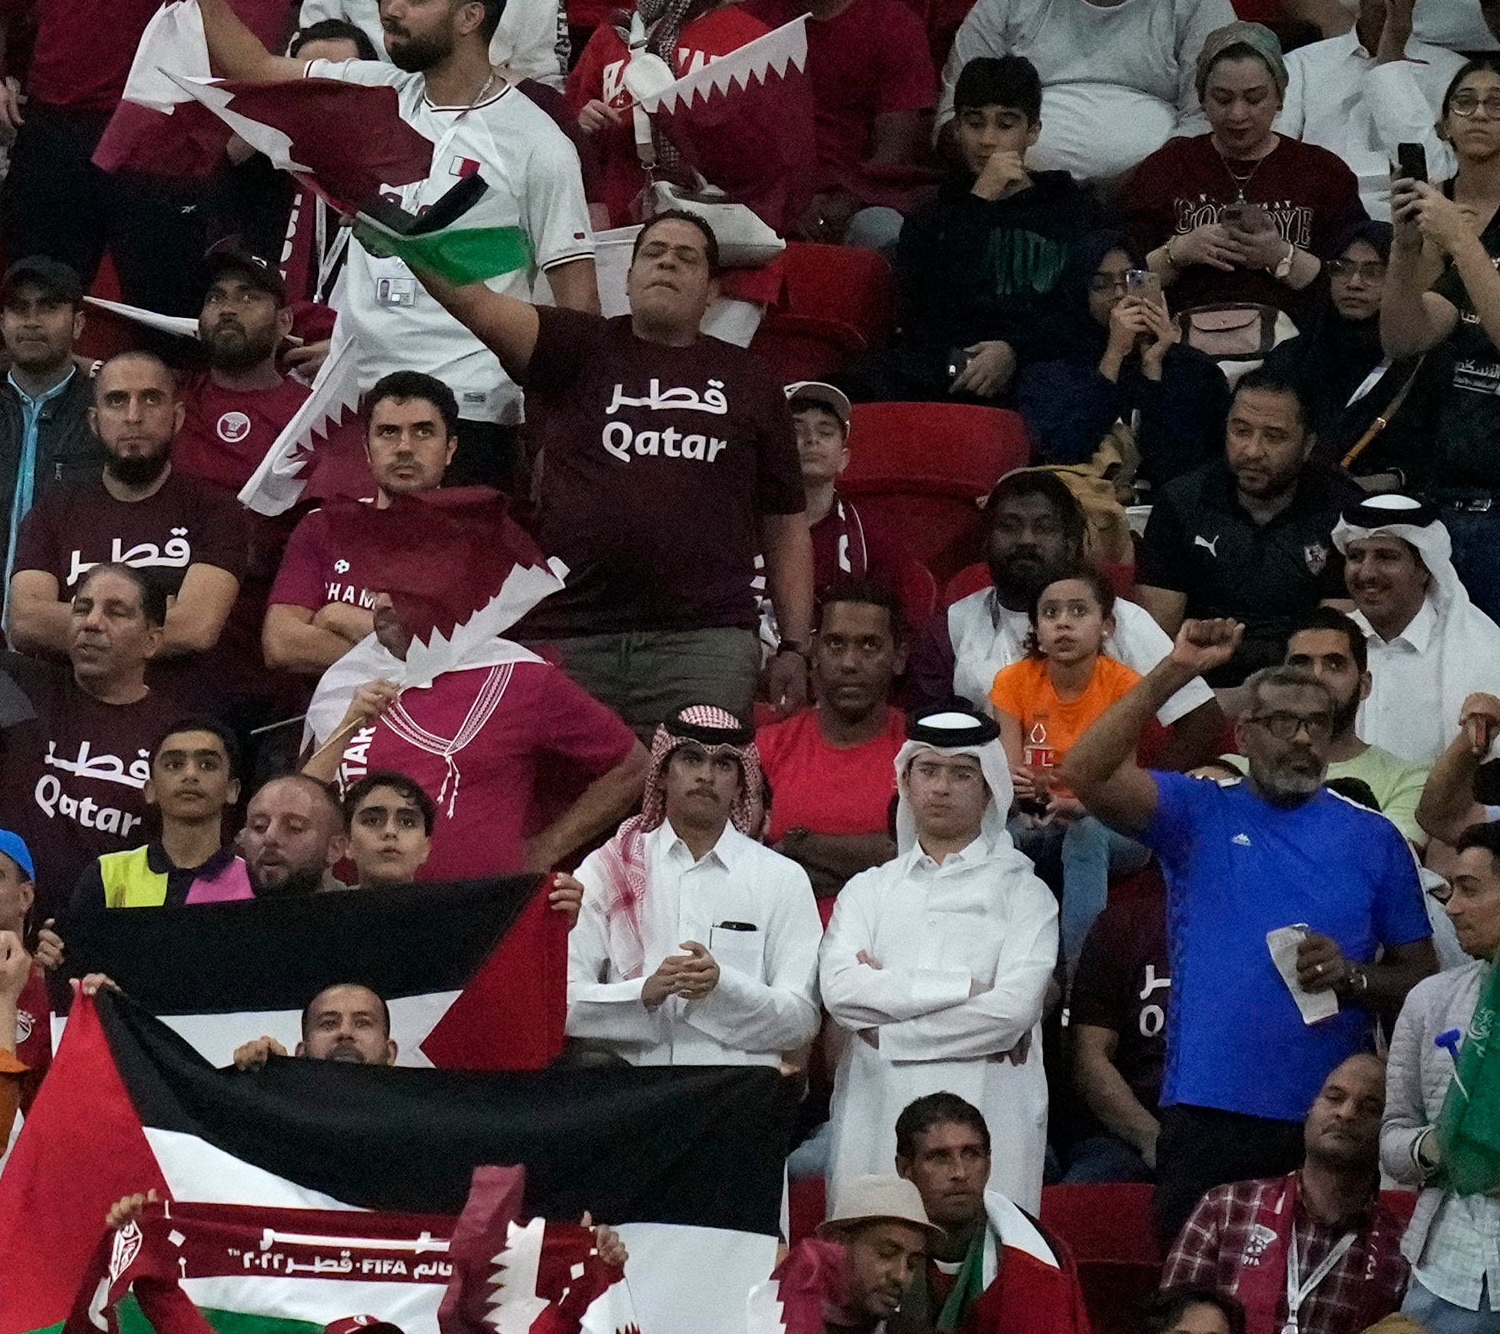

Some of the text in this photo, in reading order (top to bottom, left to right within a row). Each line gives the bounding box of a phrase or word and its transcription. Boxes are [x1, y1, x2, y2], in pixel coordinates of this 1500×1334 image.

[606, 379, 727, 414] قطر
[603, 422, 726, 462] Qatar
[67, 528, 190, 585] قطر
[35, 775, 141, 835] Qatar
[285, 1251, 407, 1278] FIFA قطر
